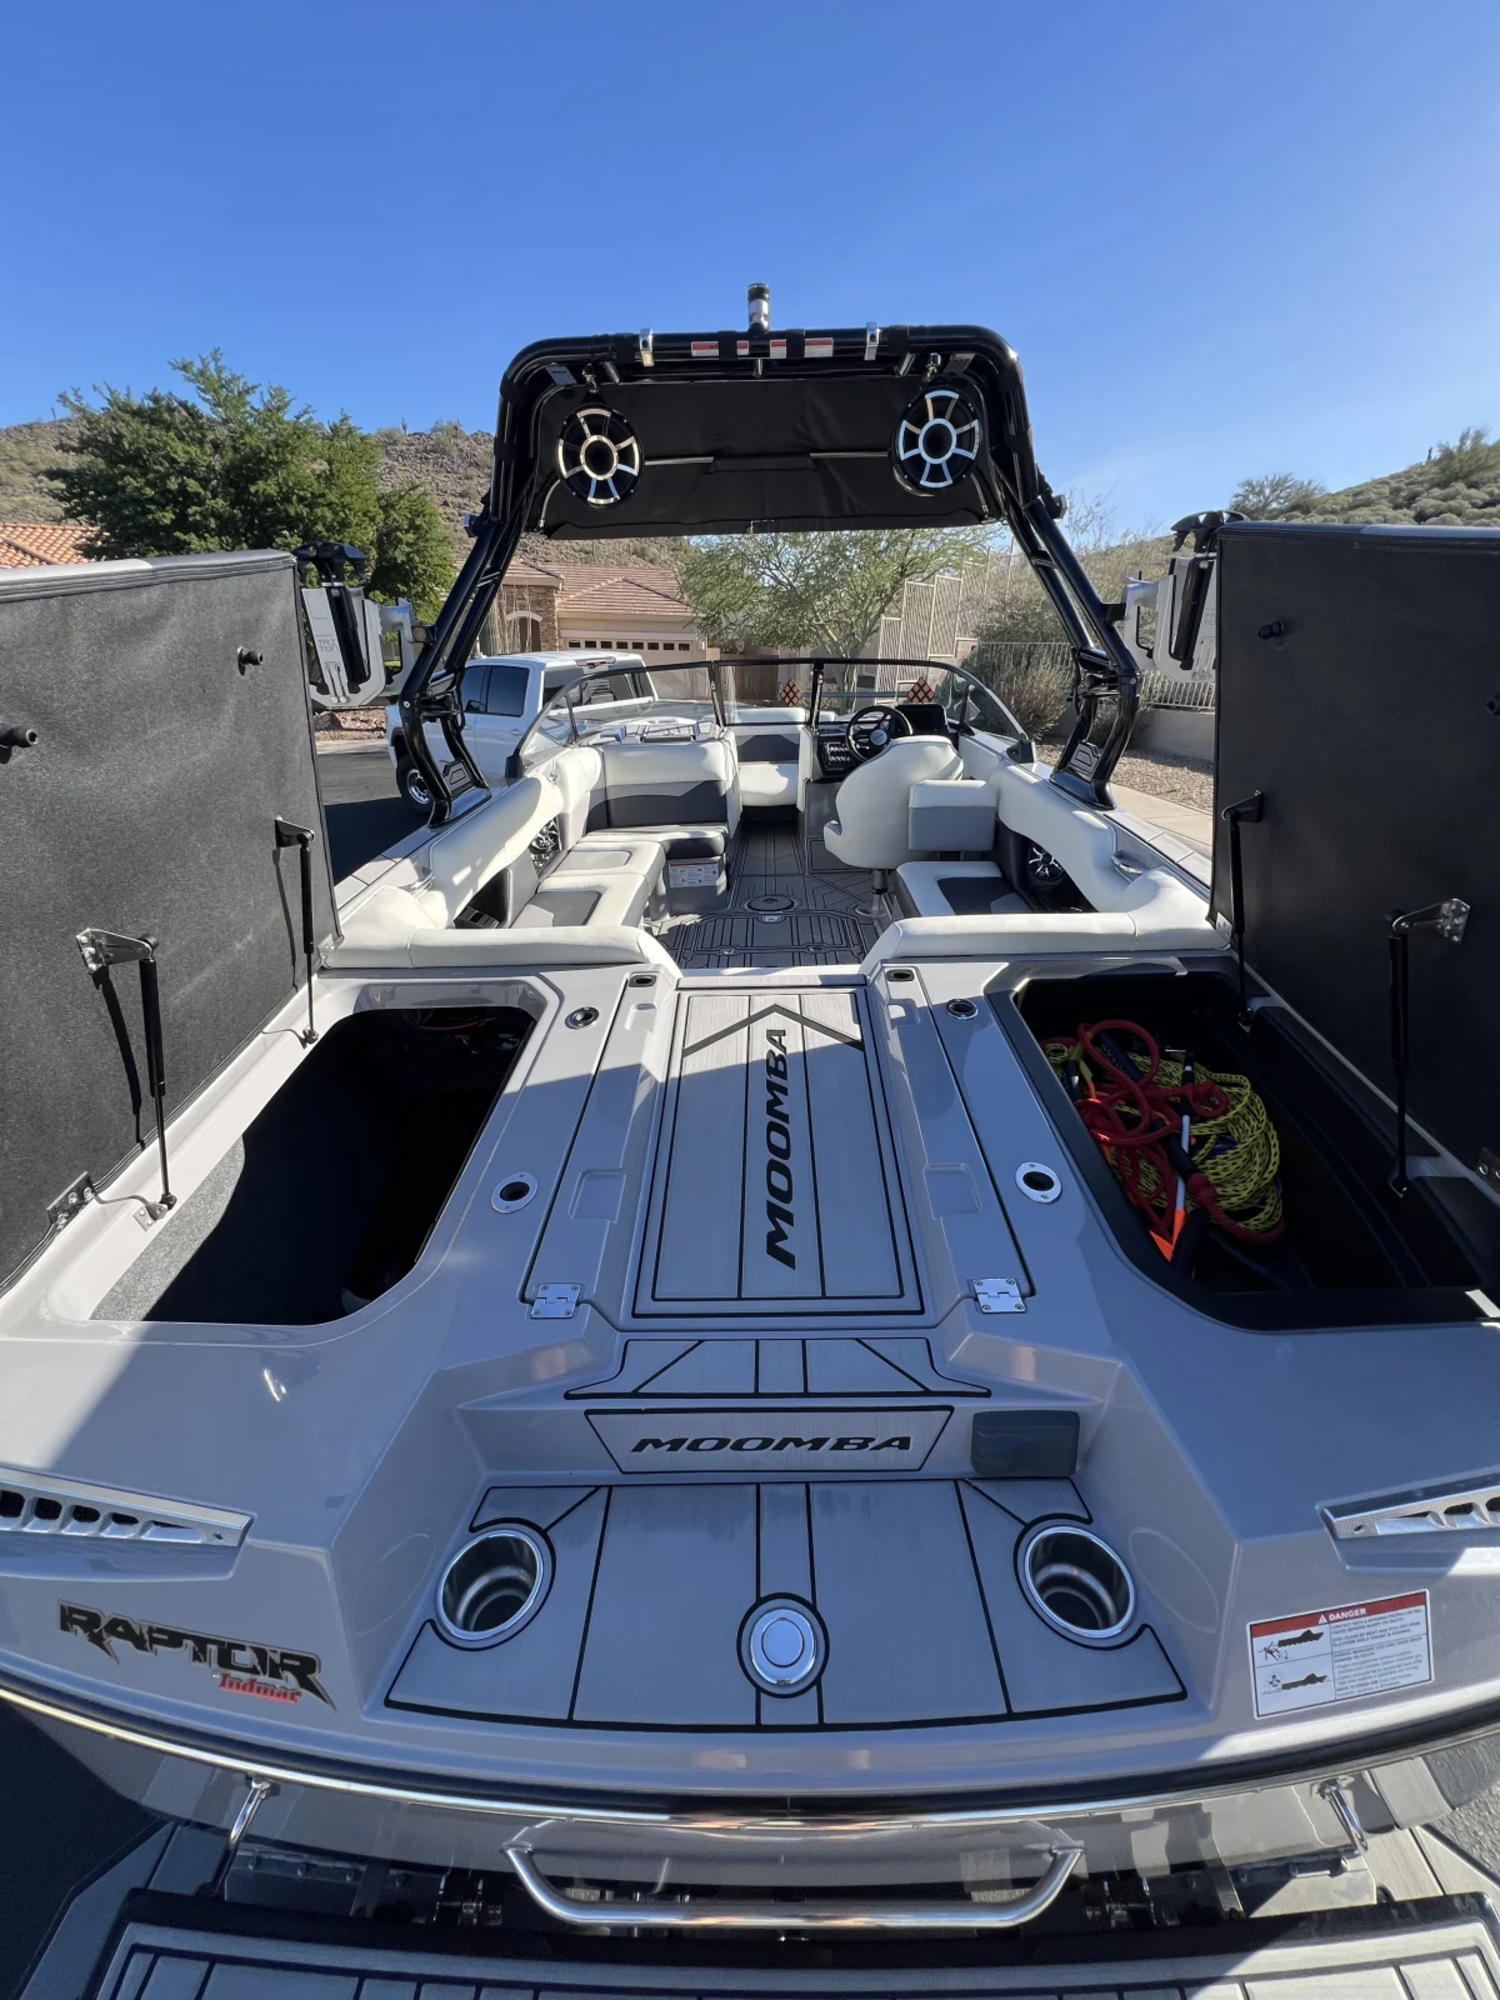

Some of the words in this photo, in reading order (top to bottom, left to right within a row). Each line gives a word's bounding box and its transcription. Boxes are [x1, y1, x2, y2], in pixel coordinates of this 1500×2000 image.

[765, 1029, 796, 1270] MOOMBA
[631, 1436, 911, 1453] MOOMBA
[1329, 1609, 1367, 1621] DANGER
[59, 1600, 336, 1711] RAPTOR
[219, 1672, 302, 1704] Indmar
